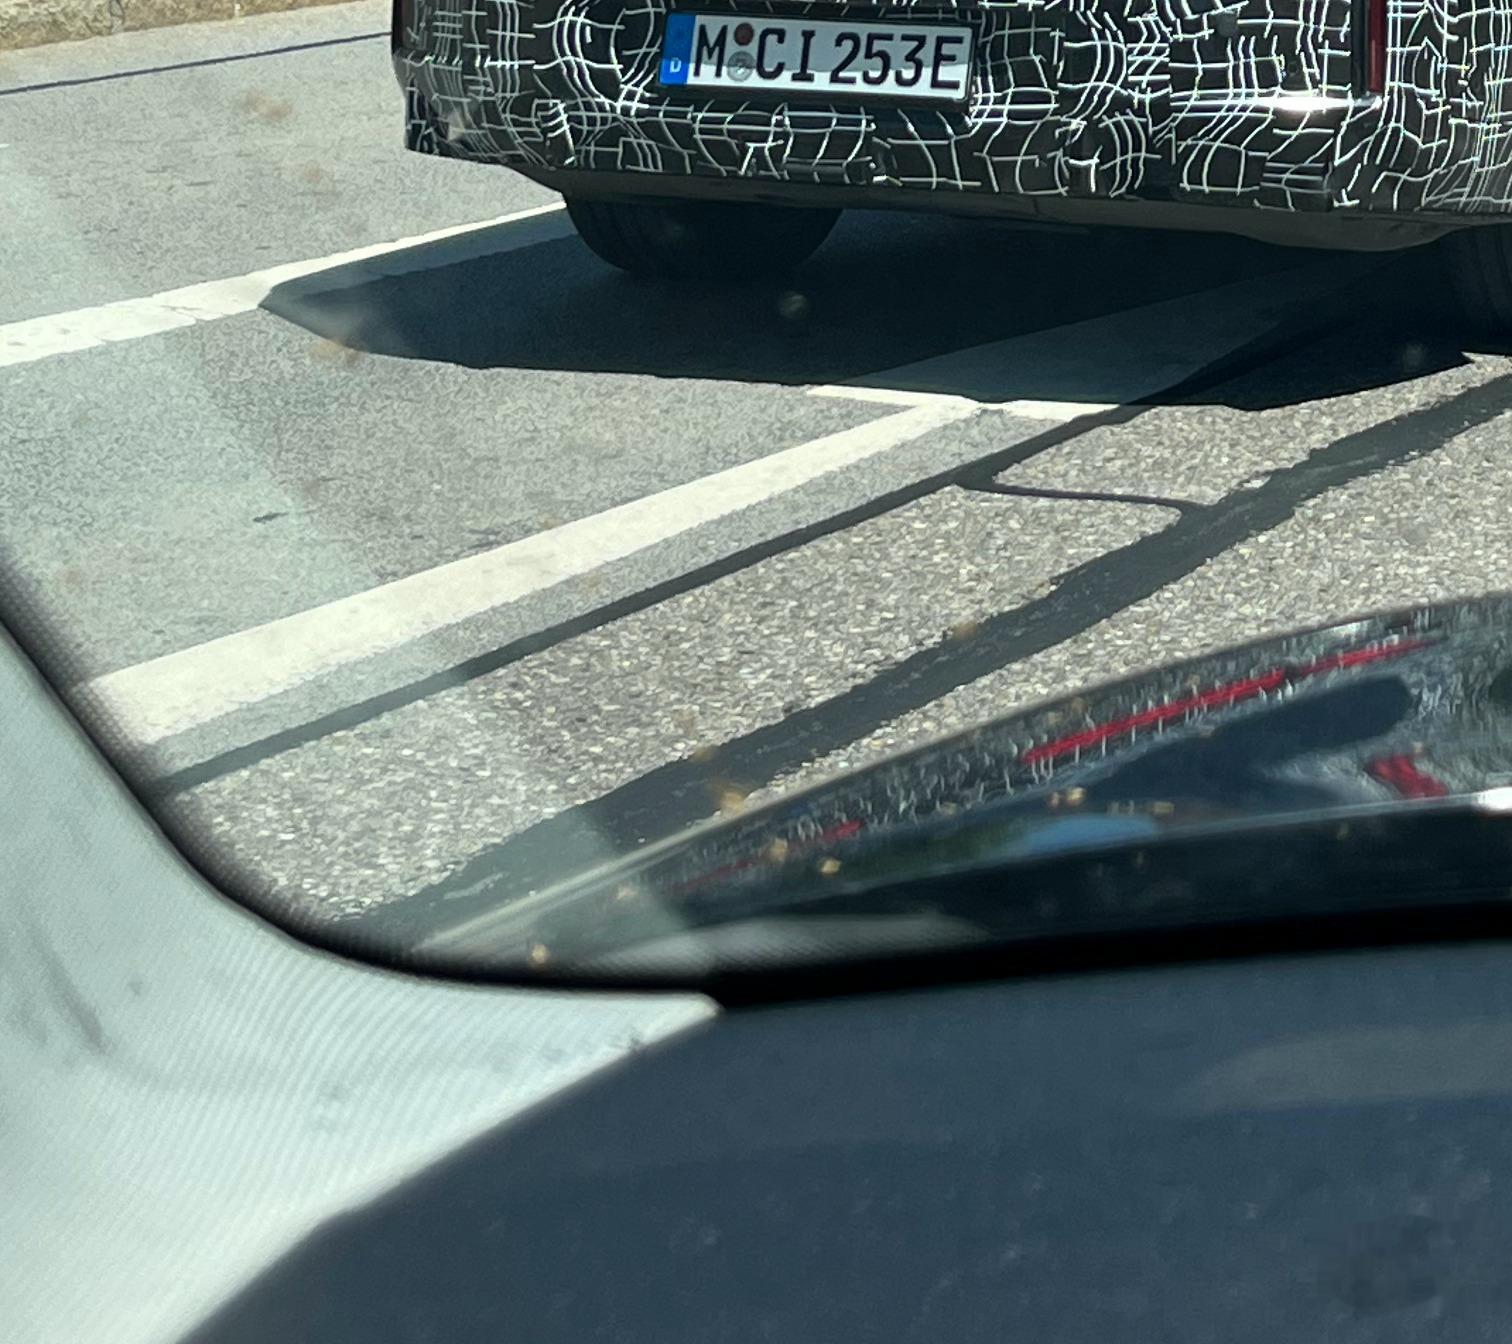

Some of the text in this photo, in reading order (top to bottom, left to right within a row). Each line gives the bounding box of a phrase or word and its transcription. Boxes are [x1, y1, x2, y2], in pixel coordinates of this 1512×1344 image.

[669, 57, 682, 73] D
[693, 23, 964, 90] M CI 253E
